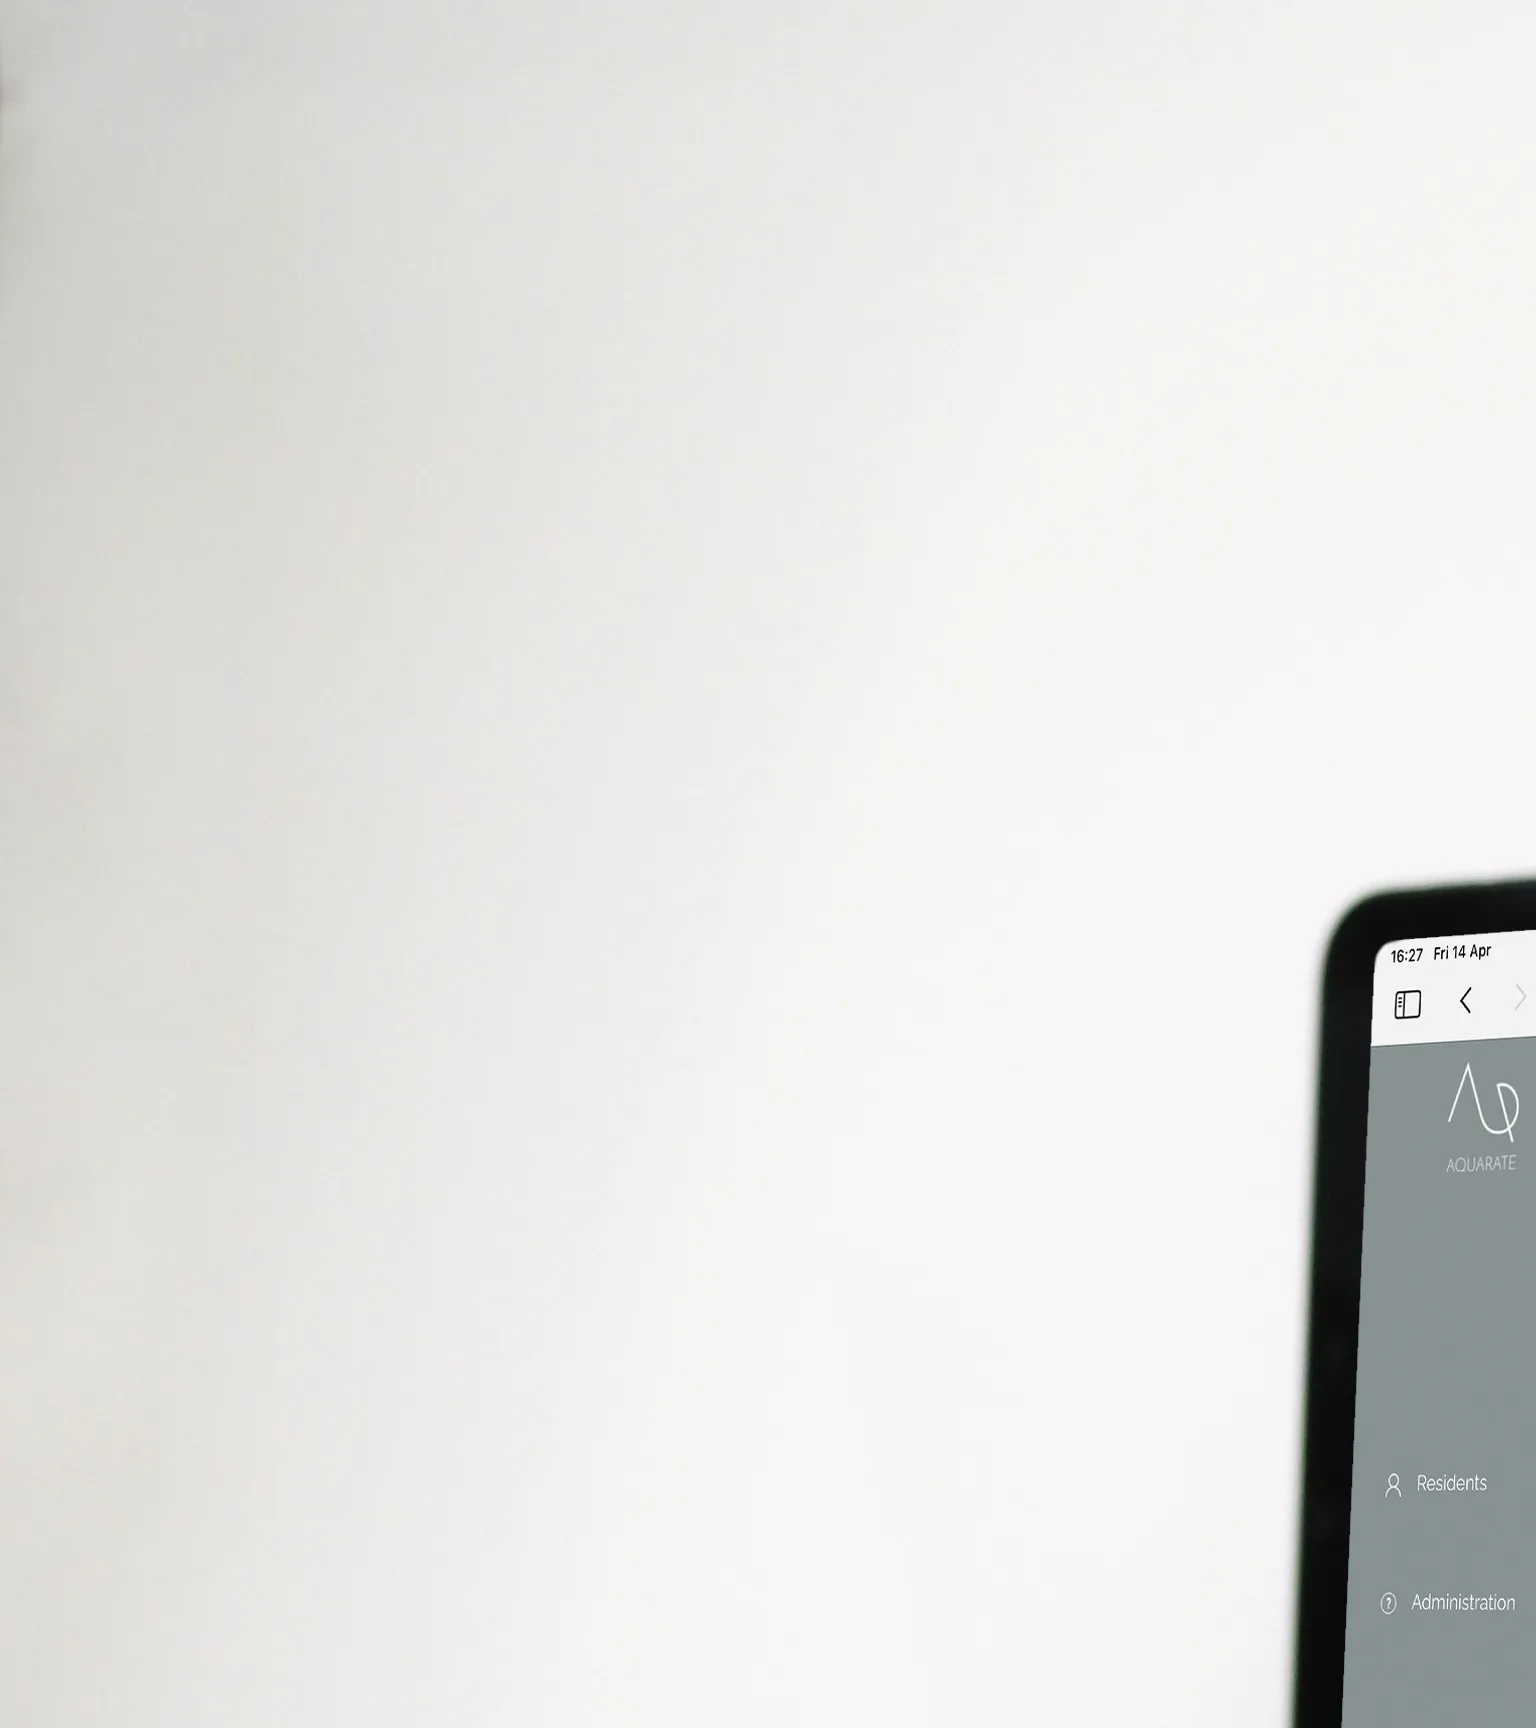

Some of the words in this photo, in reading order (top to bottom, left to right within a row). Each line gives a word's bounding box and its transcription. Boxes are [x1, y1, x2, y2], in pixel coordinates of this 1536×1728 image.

[1391, 948, 1423, 963] 16:27
[1434, 945, 1448, 960] Fri
[1453, 945, 1466, 959] 14
[1470, 944, 1492, 960] Apr
[1447, 1155, 1516, 1172] AQUARATE
[1418, 1474, 1486, 1491] Residents
[1412, 1594, 1515, 1610] Administration
